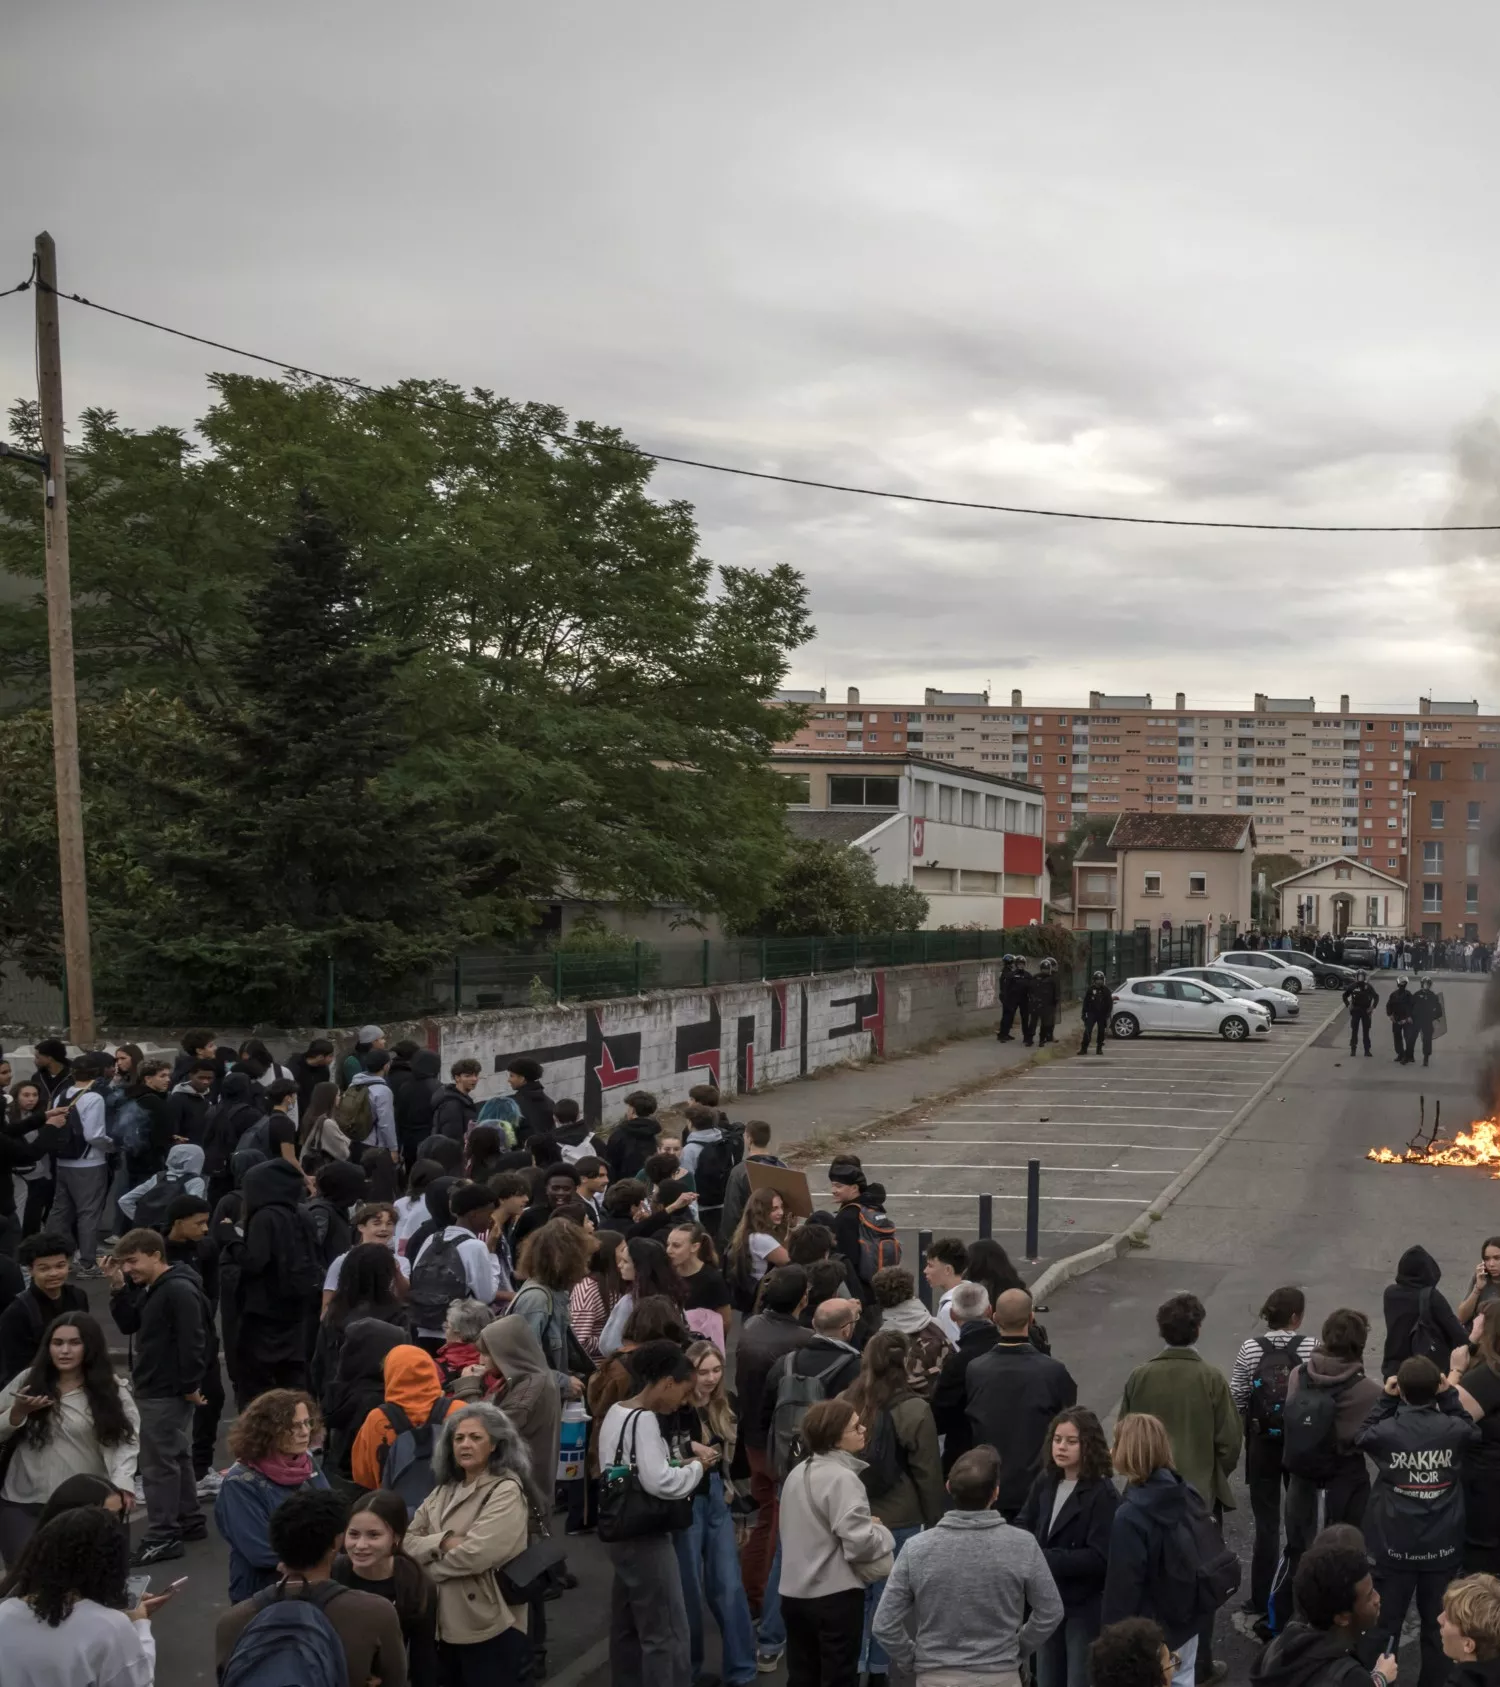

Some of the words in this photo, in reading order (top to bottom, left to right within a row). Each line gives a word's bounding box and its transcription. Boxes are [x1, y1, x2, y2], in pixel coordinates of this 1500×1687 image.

[1389, 1449, 1453, 1470] DRAKKAR
[1409, 1471, 1439, 1483] NOIR
[1388, 1548, 1402, 1560] Guy
[1405, 1551, 1438, 1560] Laroche
[1439, 1545, 1456, 1558] Paris
